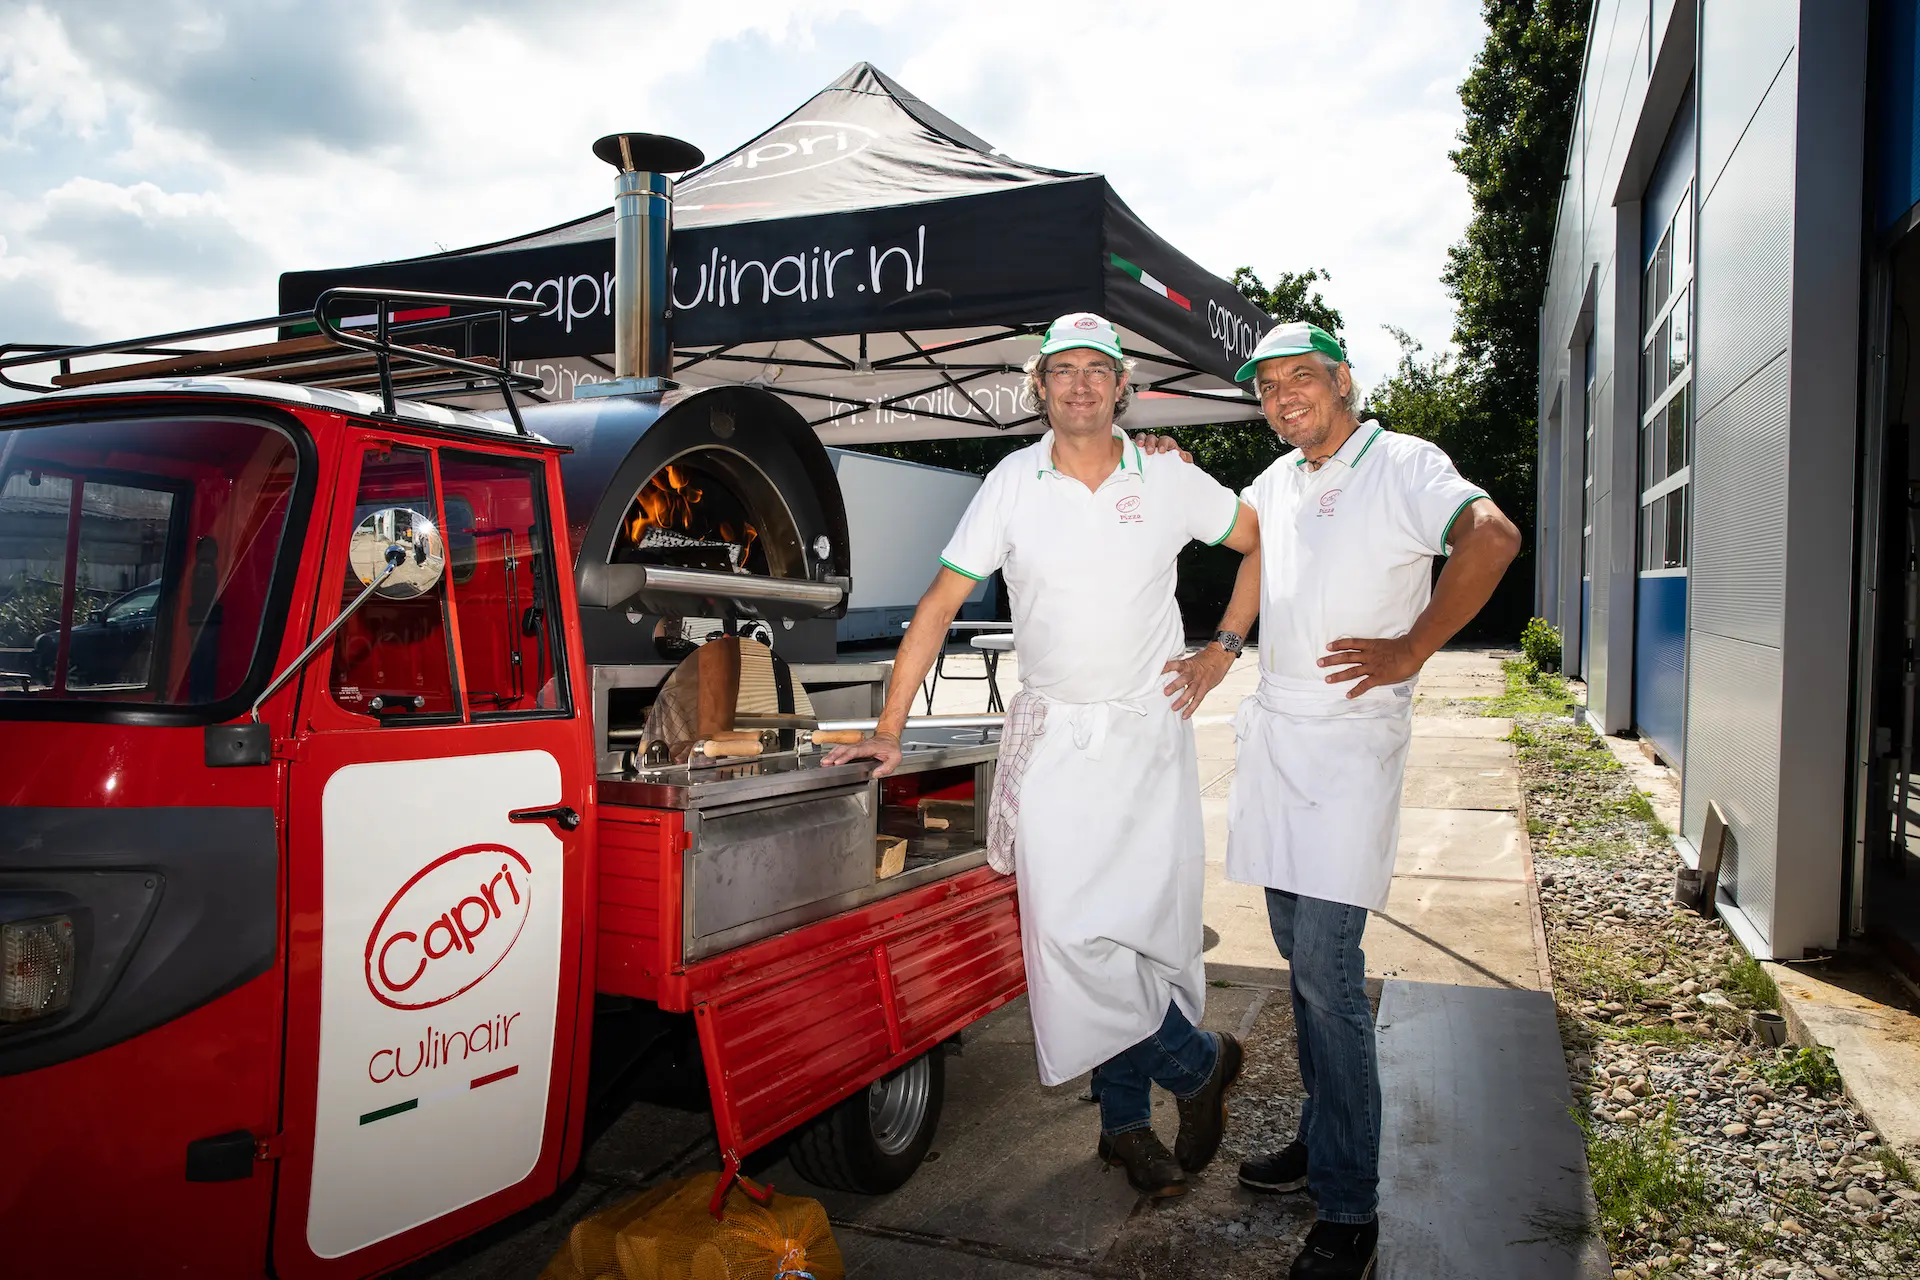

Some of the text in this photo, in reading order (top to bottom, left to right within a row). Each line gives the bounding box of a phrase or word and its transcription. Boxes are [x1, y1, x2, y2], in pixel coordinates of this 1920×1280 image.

[688, 131, 848, 185] apri
[506, 224, 926, 334] caprulinair.nl
[378, 863, 521, 992] Capri
[368, 1011, 521, 1084] culinair
